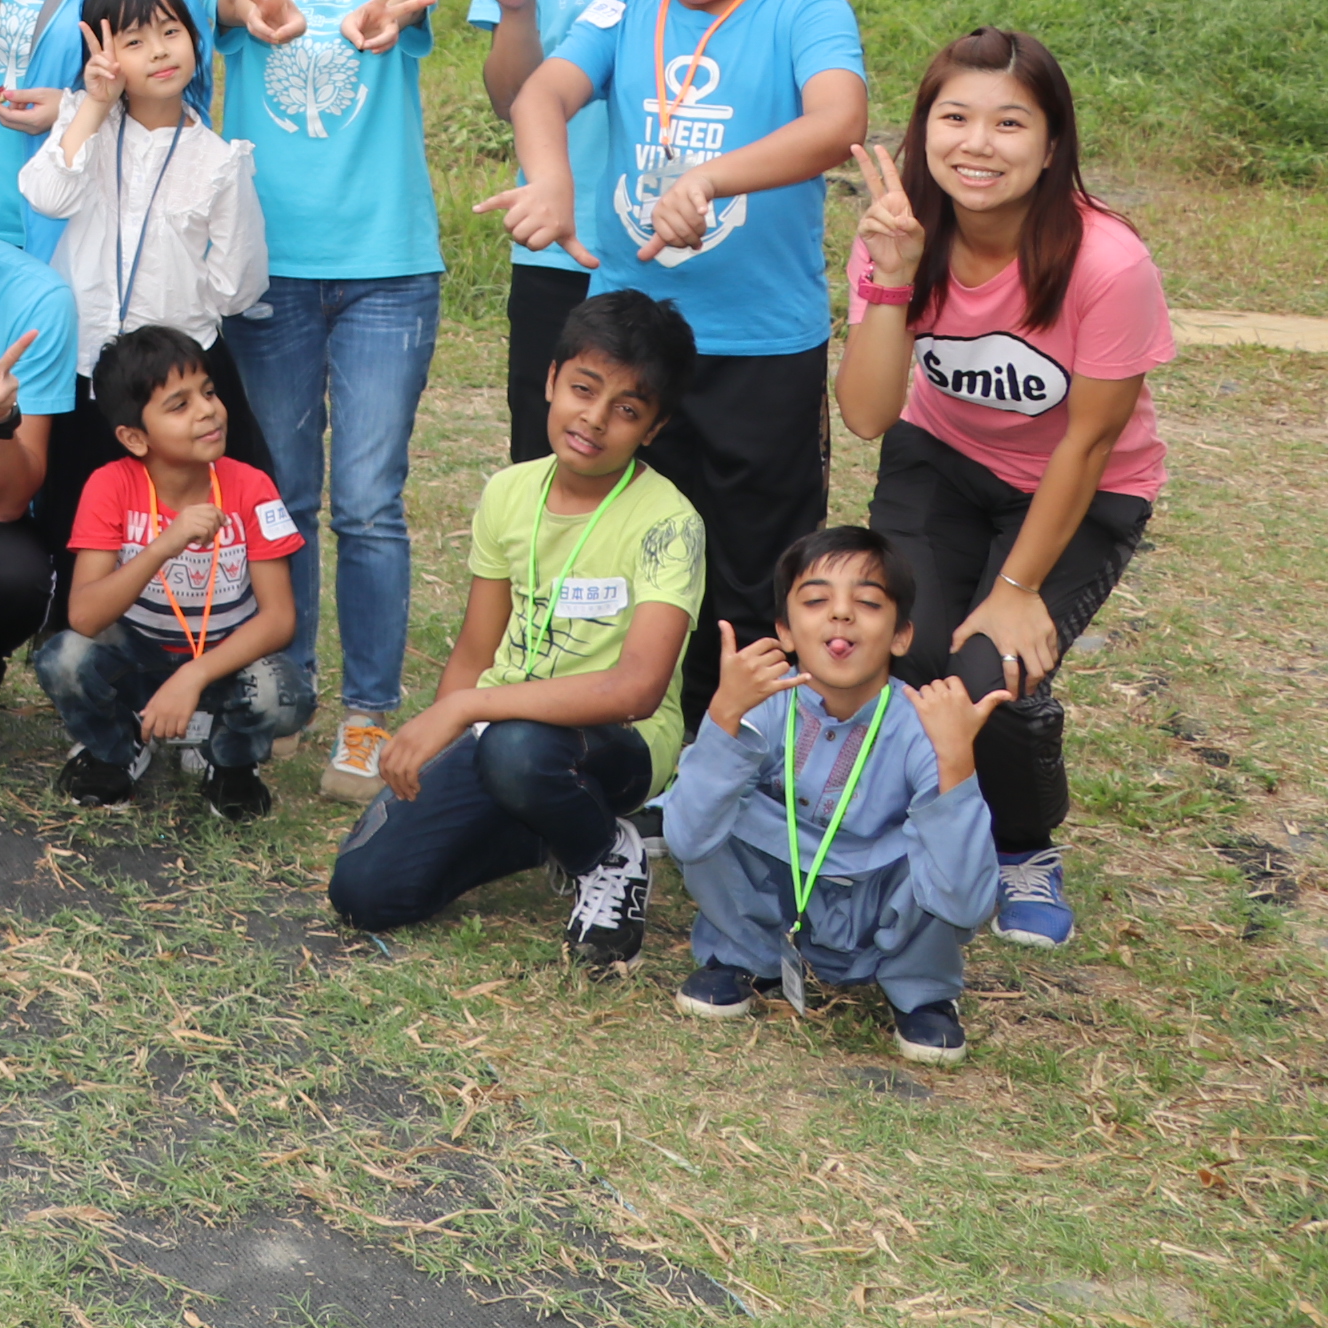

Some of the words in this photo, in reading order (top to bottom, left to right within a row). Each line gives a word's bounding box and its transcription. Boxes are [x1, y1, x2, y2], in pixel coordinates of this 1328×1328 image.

[645, 116, 653, 143] I
[923, 350, 1047, 402] Smile
[560, 586, 618, 601] 日本命力
